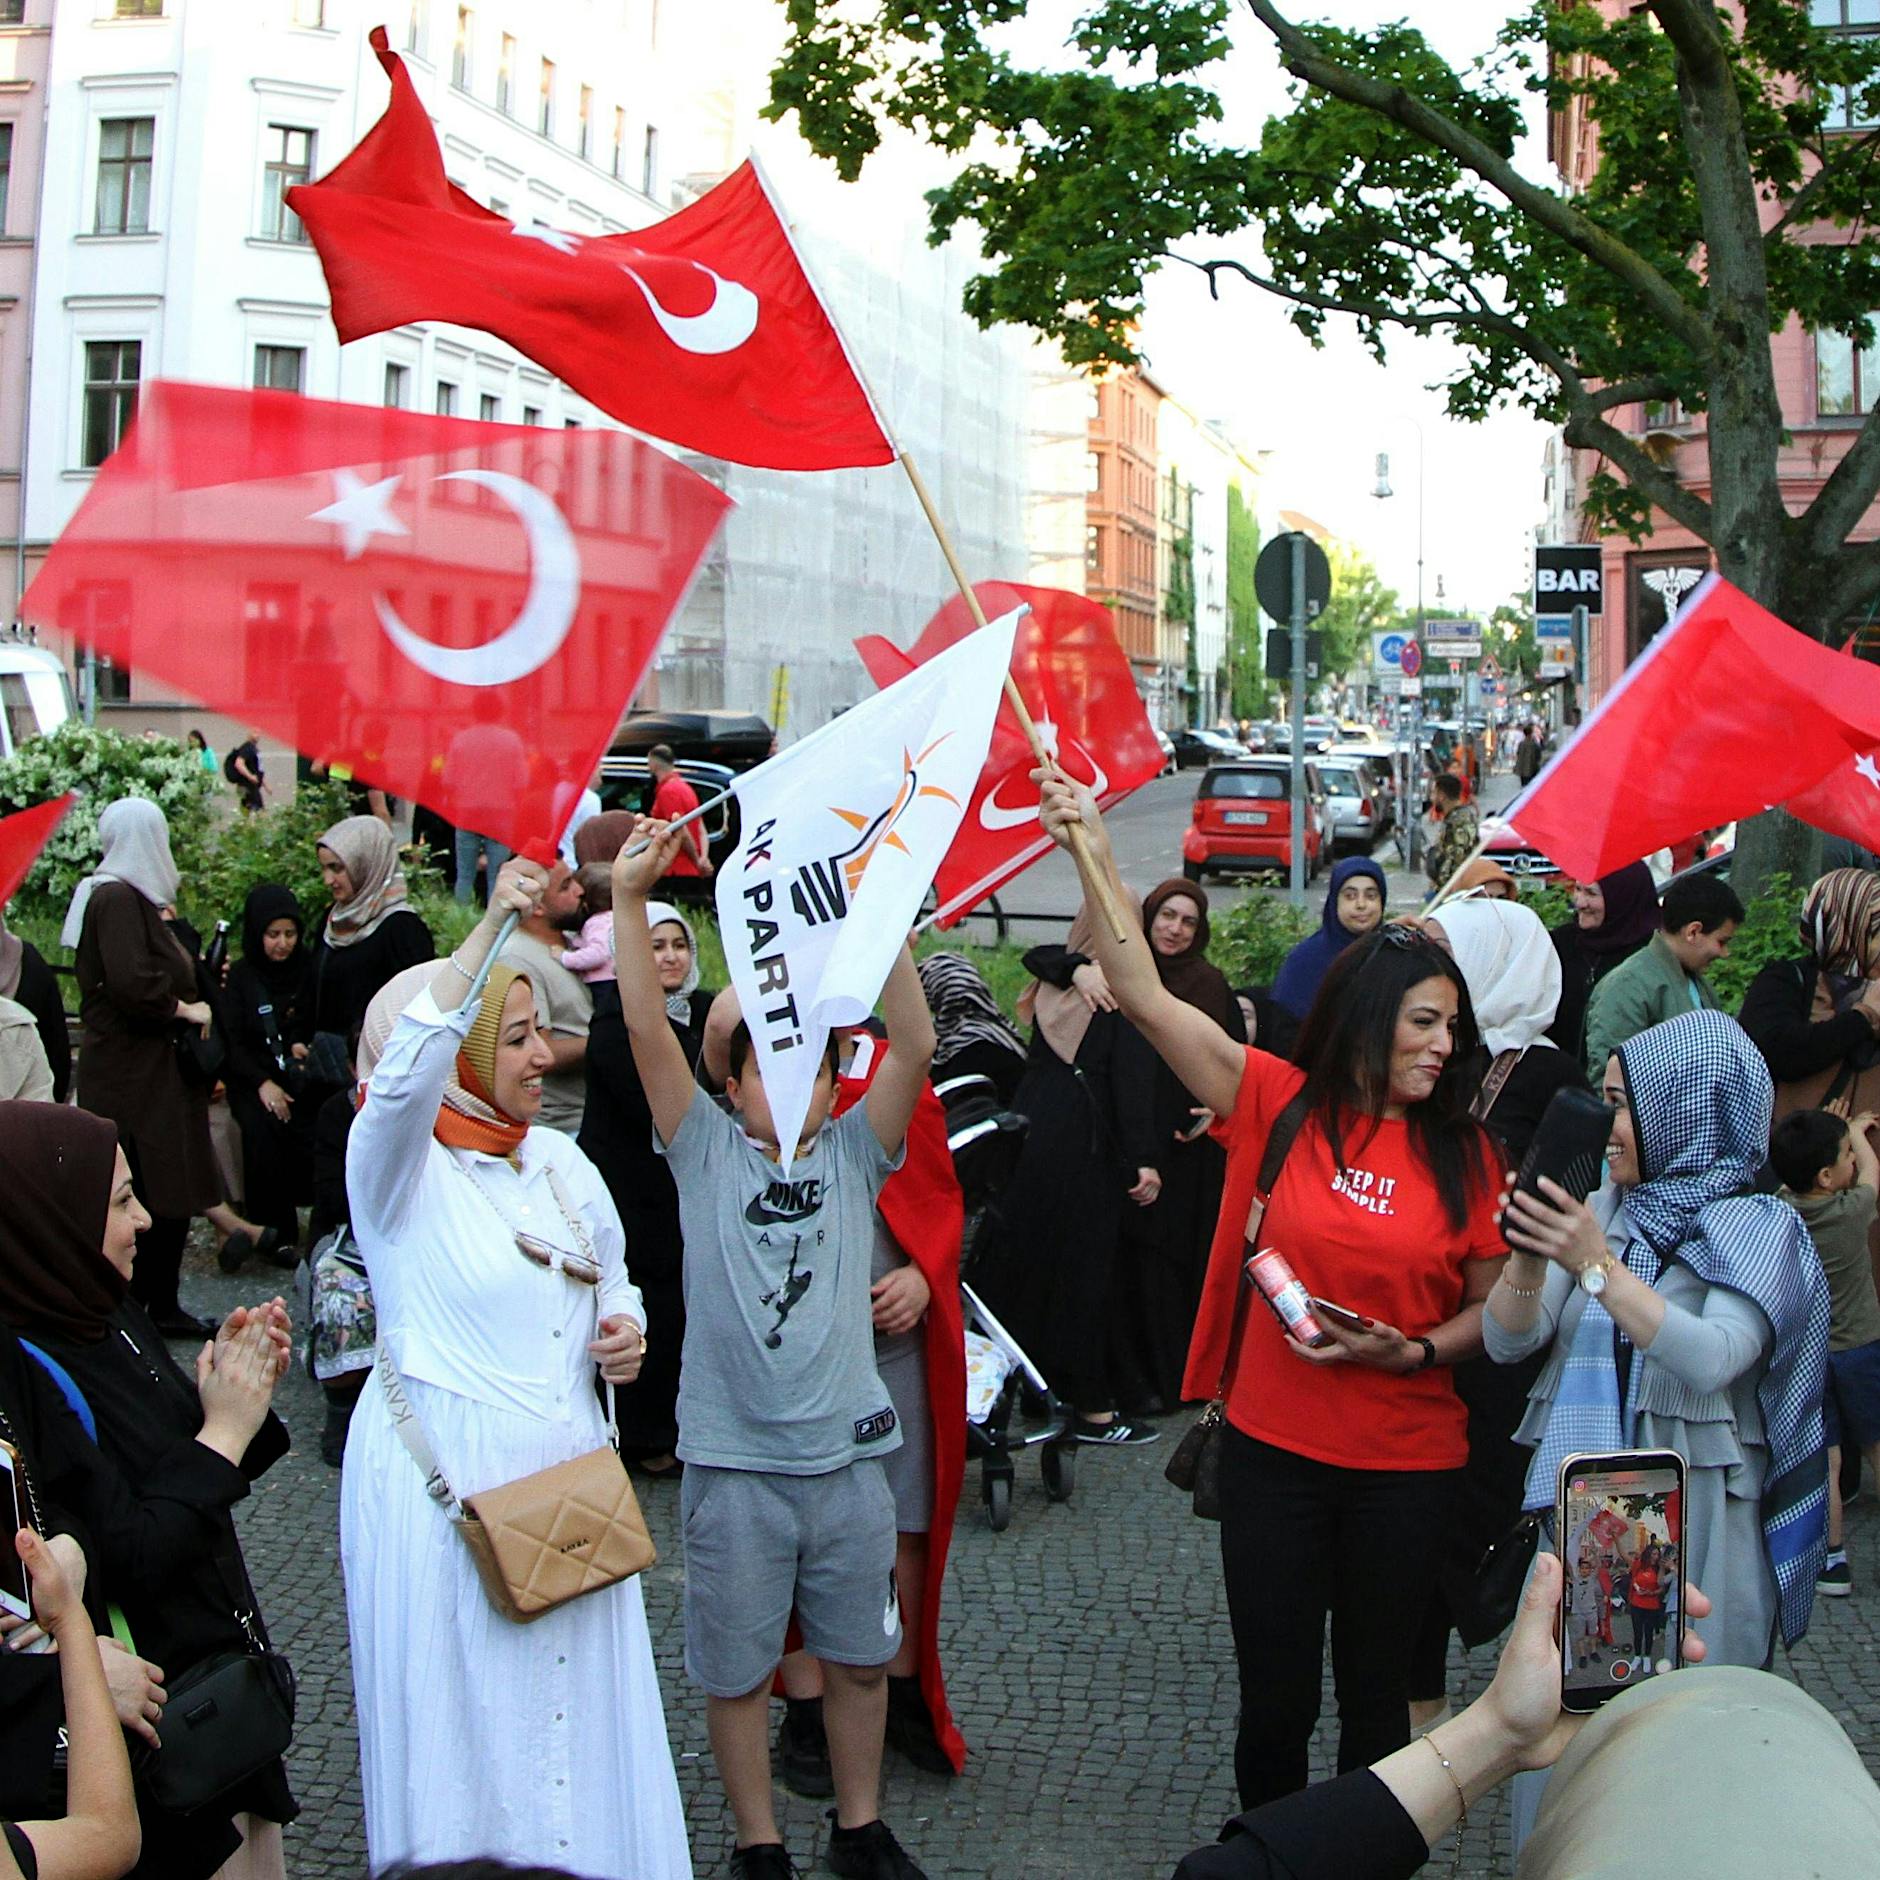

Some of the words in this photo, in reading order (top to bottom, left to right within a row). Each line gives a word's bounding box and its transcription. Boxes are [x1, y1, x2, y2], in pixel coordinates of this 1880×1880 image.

[1537, 569, 1600, 592] BAR
[743, 818, 777, 873] AK
[763, 1179, 821, 1212] NIKE
[1377, 1176, 1396, 1197] IT
